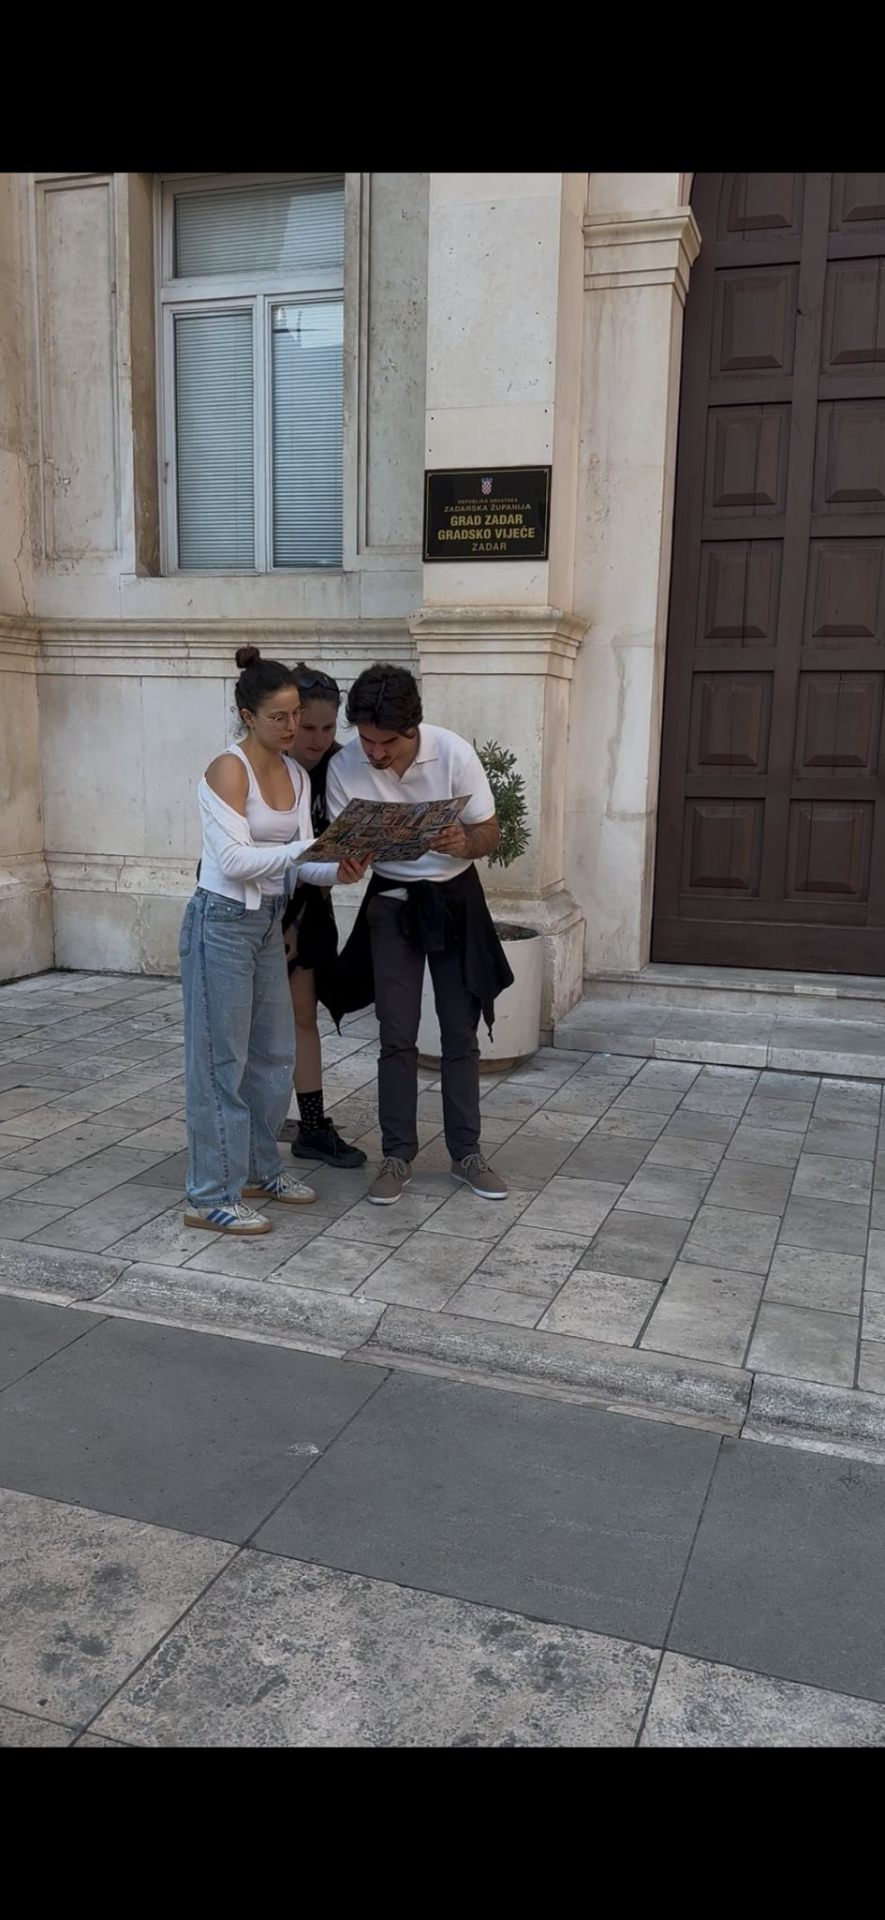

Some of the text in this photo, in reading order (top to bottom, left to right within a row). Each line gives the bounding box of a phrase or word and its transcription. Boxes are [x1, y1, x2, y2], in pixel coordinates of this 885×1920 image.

[490, 503, 531, 511] ŽUPANIJA
[450, 514, 523, 526] GRAD ZADAR
[438, 525, 535, 540] GRADSKO VIJEĆE
[472, 542, 507, 551] ZADAR
